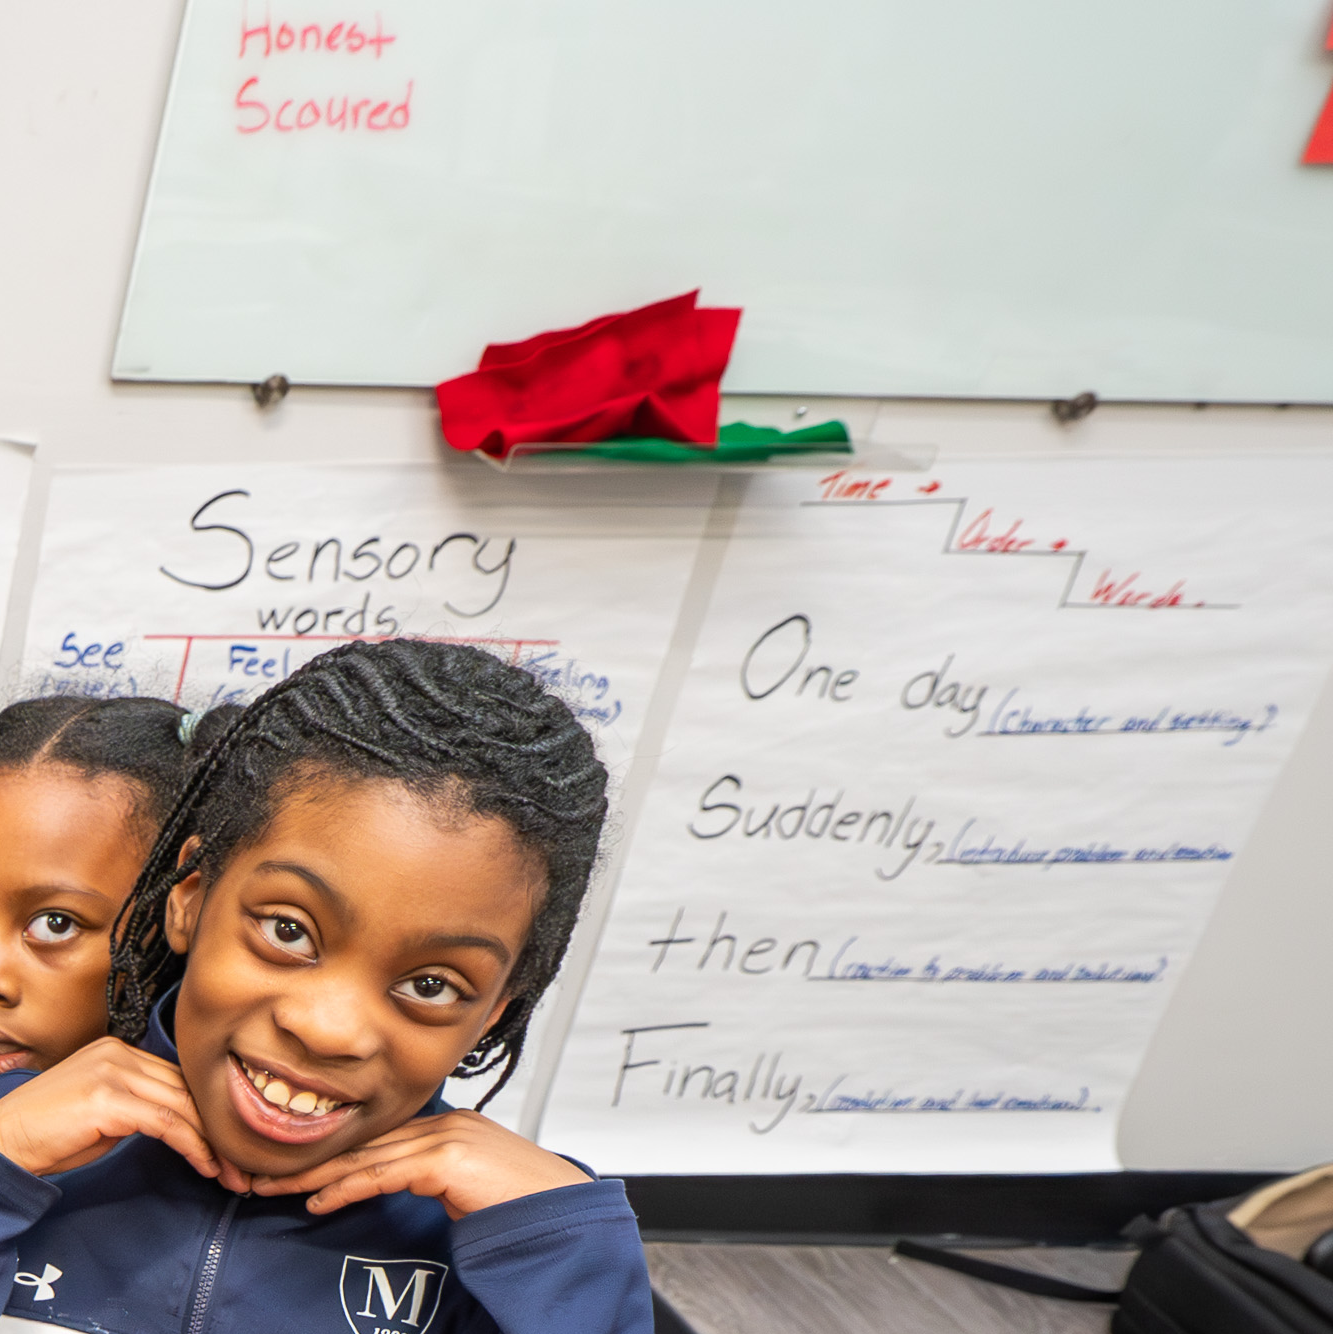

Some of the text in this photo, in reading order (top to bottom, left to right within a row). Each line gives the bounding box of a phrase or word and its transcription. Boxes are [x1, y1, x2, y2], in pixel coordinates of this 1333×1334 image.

[237, 2, 396, 60] Honest
[234, 76, 415, 134] Scoured
[818, 470, 893, 500] Time
[159, 488, 517, 618] Sensory
[957, 507, 1035, 553] Order
[257, 591, 400, 637] words
[53, 631, 125, 670] See
[228, 645, 291, 680] Feel
[740, 614, 860, 701] One
[900, 653, 988, 738] day
[649, 905, 821, 977] then
[356, 1265, 436, 1327] M
